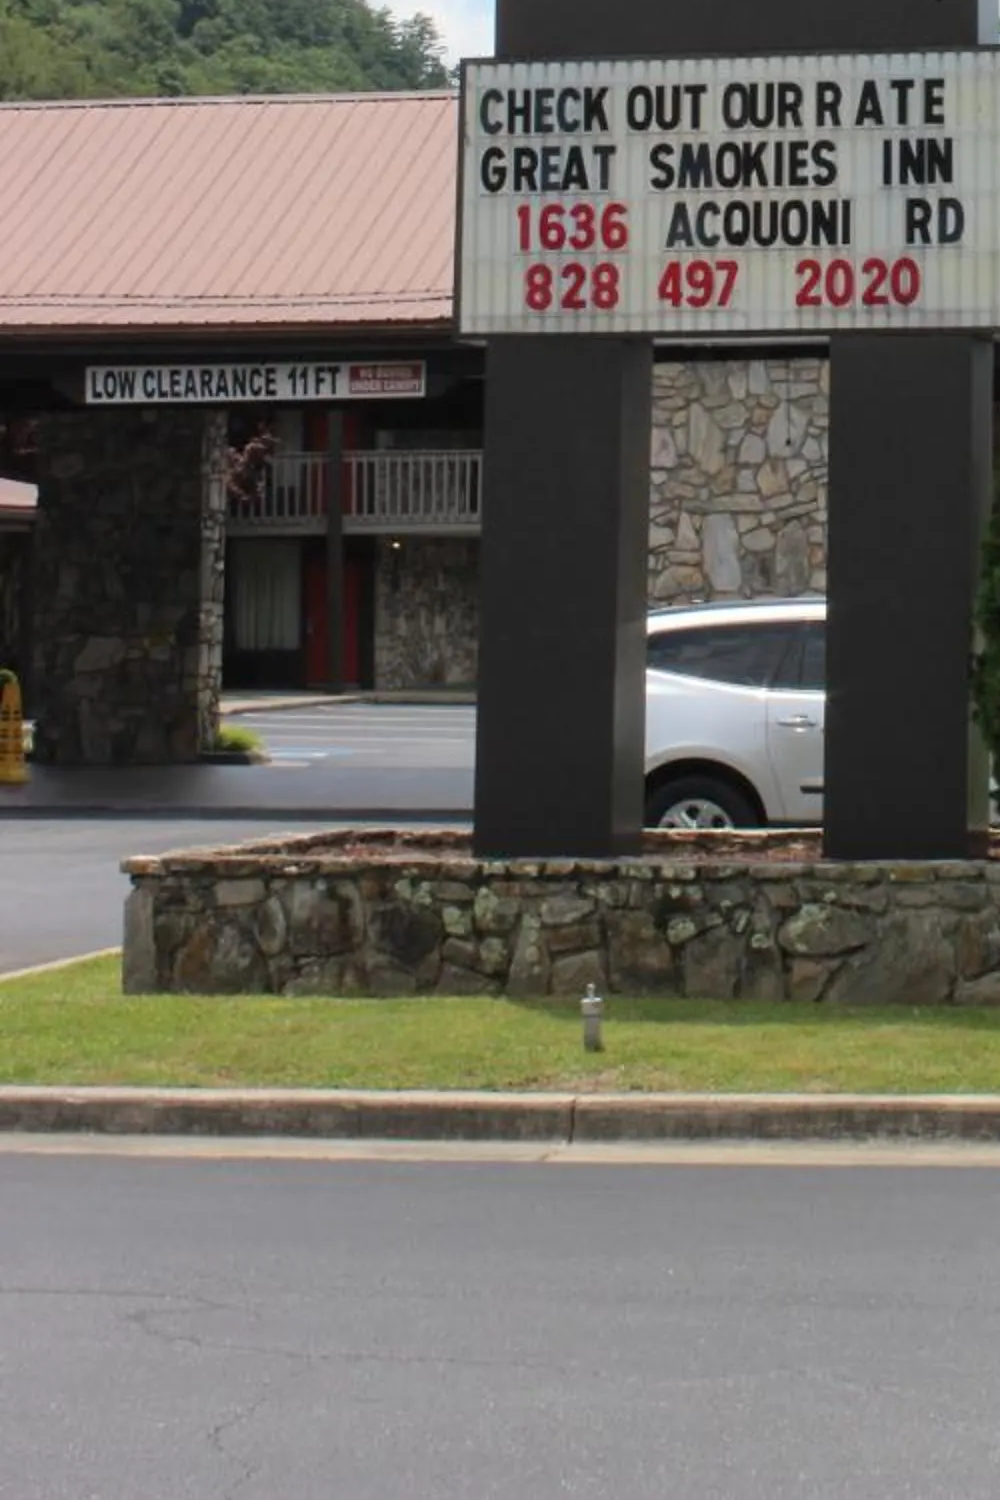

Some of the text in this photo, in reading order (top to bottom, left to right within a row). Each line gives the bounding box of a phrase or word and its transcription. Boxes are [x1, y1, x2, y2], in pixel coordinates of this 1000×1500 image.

[479, 86, 609, 135] CHECK
[626, 84, 707, 131] OUT
[722, 82, 803, 129] OUR
[480, 137, 954, 192] GREAT SMOKIES INN
[516, 197, 965, 252] 1636 ACQUONI RD
[525, 257, 921, 311] 828 497 2020
[91, 369, 138, 399] LOW
[142, 366, 278, 398] CLEARANCE
[315, 366, 341, 395] FT
